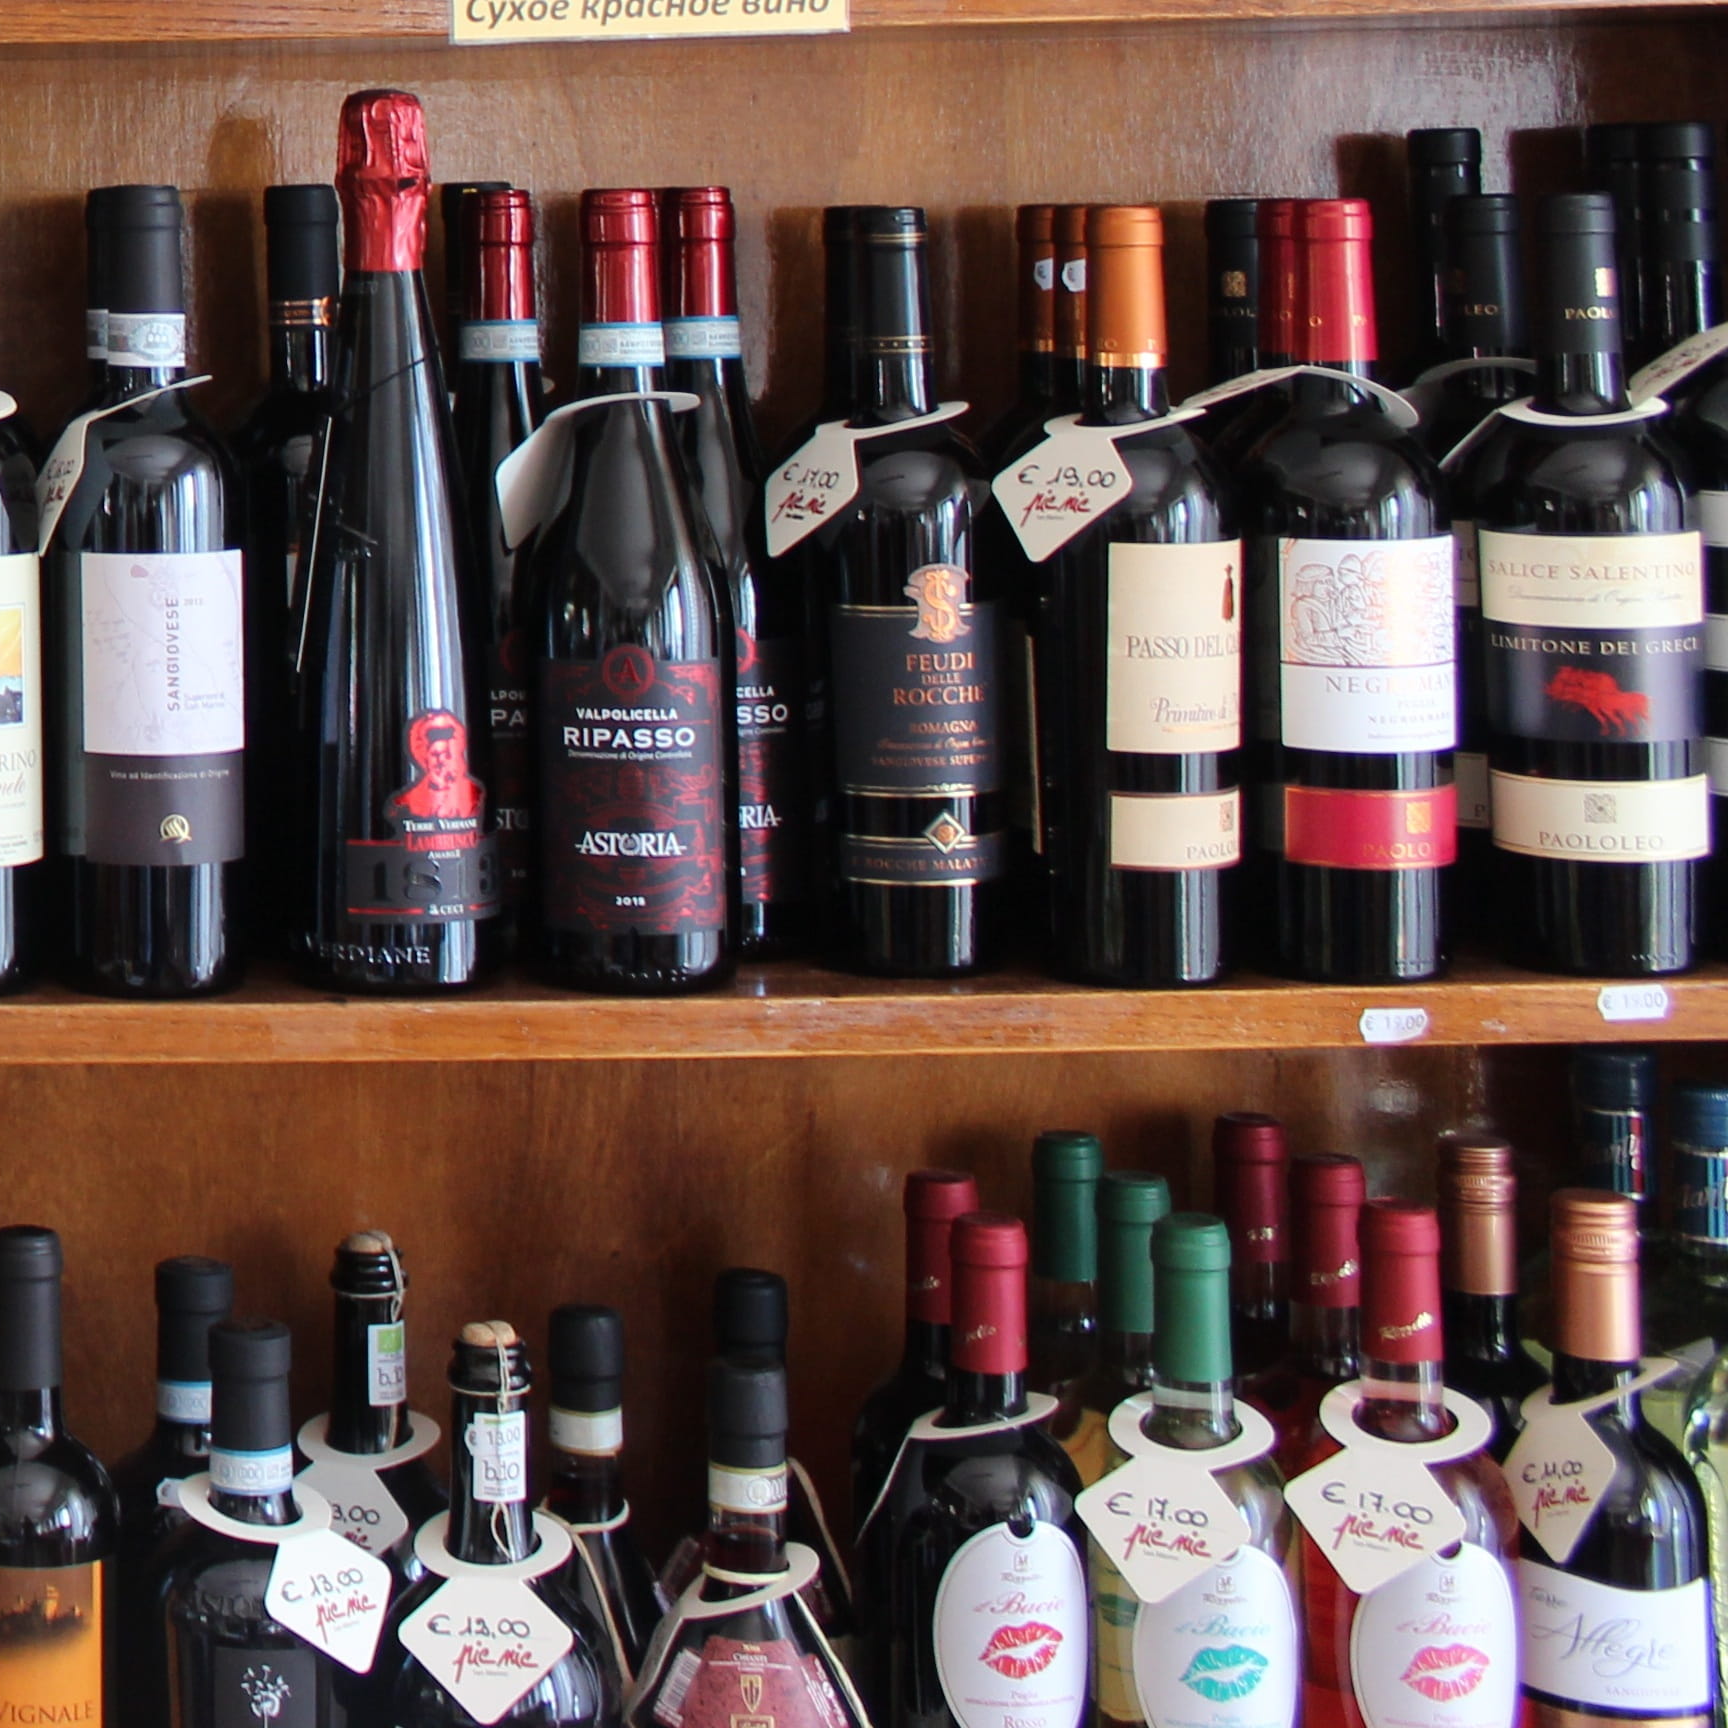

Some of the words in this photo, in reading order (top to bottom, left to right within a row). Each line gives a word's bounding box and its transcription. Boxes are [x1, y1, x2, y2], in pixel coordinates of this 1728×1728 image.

[1488, 560, 1559, 579] SALICE
[167, 595, 181, 712] SANGIOVESE
[1491, 632, 1591, 652] LIMITONE
[1599, 642, 1637, 655] DEI
[1645, 637, 1698, 654] GRECI
[905, 654, 974, 672] FEUDI
[576, 705, 679, 721] VALPOLICELLA
[563, 726, 696, 749] RIPASSO
[581, 830, 683, 857] ASTORIA
[1537, 831, 1664, 849] PAOLOLEO
[1106, 1494, 1130, 1516] €
[1148, 1496, 1210, 1529] 17.00
